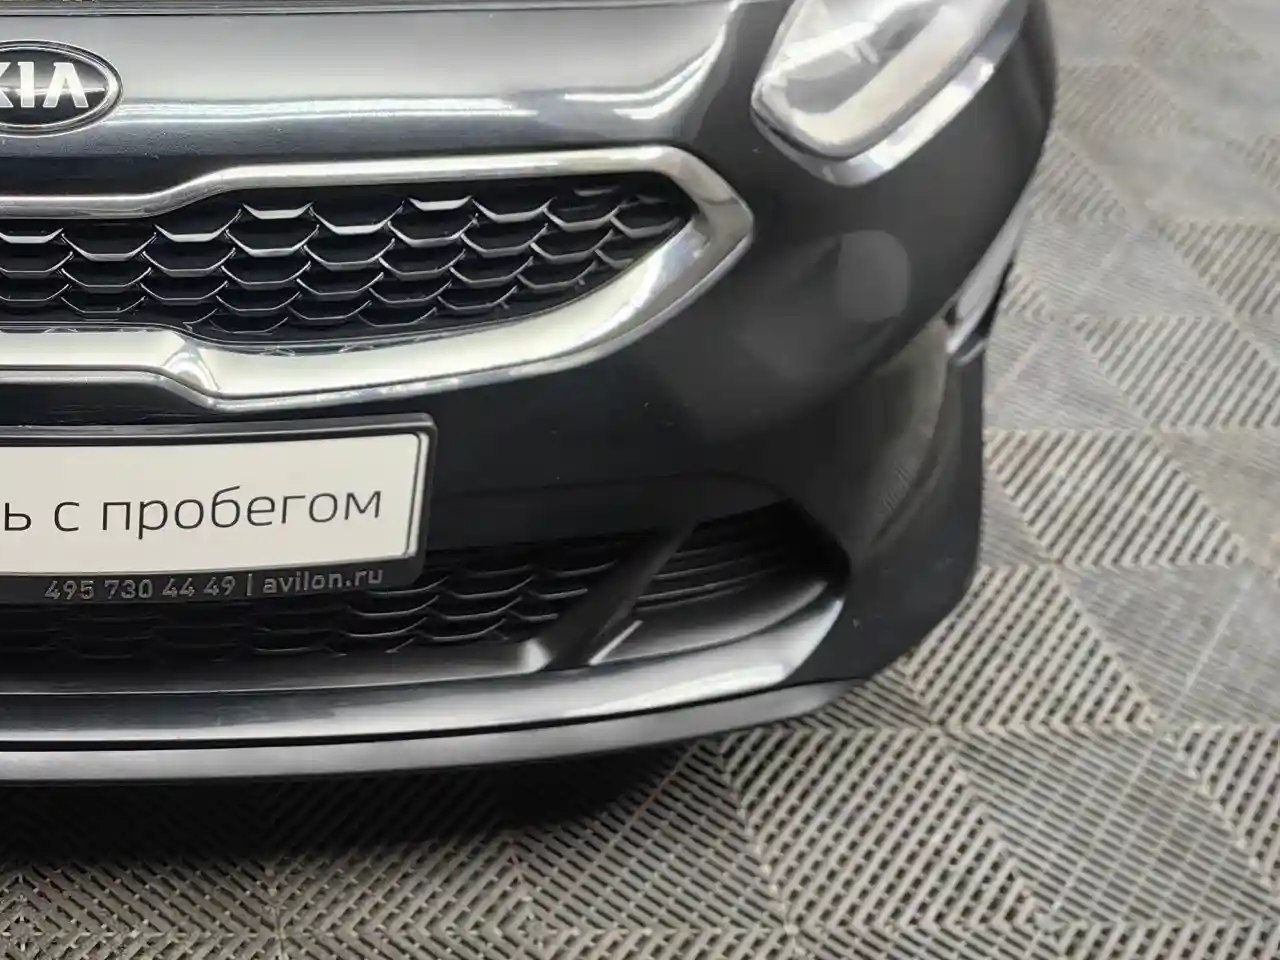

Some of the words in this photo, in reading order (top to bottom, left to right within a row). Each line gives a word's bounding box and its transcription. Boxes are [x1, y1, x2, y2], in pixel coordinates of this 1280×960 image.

[53, 500, 80, 532] с
[101, 485, 382, 540] пробегом
[44, 580, 96, 600] 495
[104, 578, 154, 600] 730
[161, 577, 196, 598] 44
[203, 575, 237, 597] 49
[262, 567, 384, 595] avilon.ru
